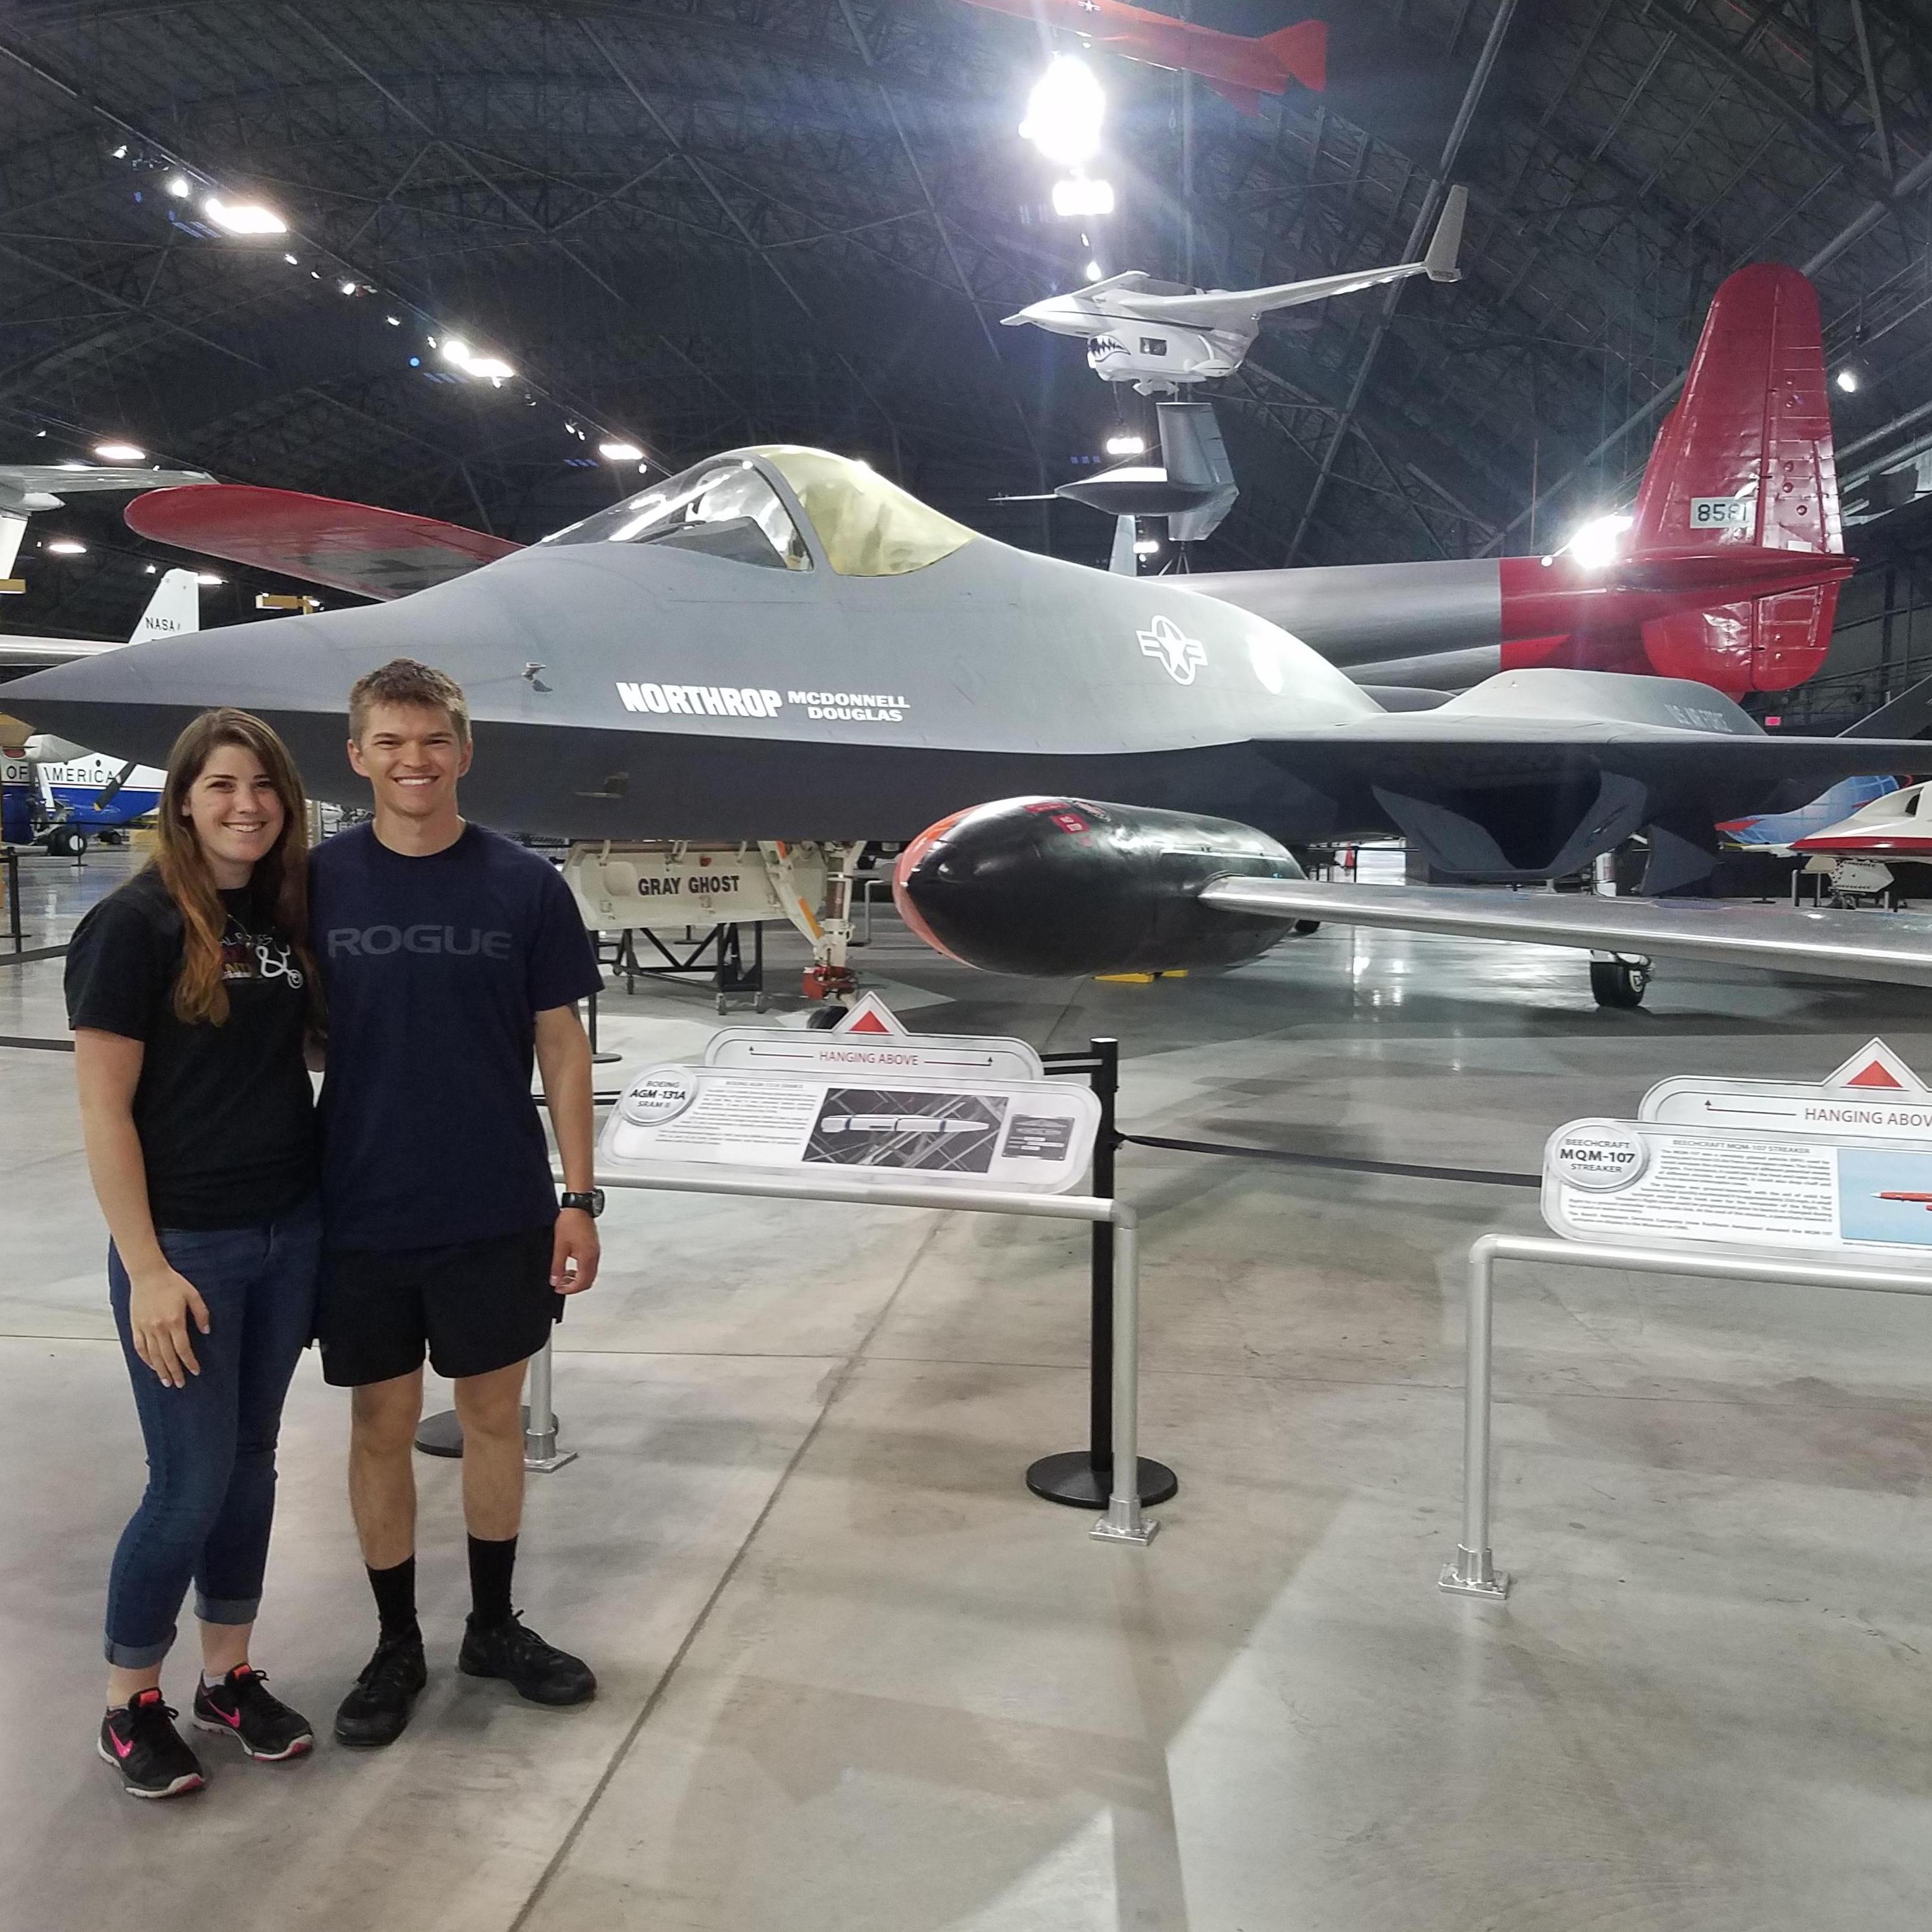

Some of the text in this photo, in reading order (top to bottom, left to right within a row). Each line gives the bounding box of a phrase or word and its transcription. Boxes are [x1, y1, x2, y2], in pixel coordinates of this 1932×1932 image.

[145, 617, 175, 632] NASA
[616, 682, 783, 718] NORTHROP
[787, 691, 911, 709] MCDONNELL
[807, 707, 904, 722] DOUGLAS
[6, 766, 28, 779] OF
[638, 875, 740, 896] GRAY GHOST
[328, 925, 513, 959] ROGUE
[820, 1051, 918, 1065] HANGING ABOVE
[1805, 1108, 1882, 1124] HANGING
[1565, 1138, 1630, 1148] BEECHCRAFT
[1560, 1148, 1636, 1164] MQM-107
[1571, 1163, 1622, 1173] STREAKER
